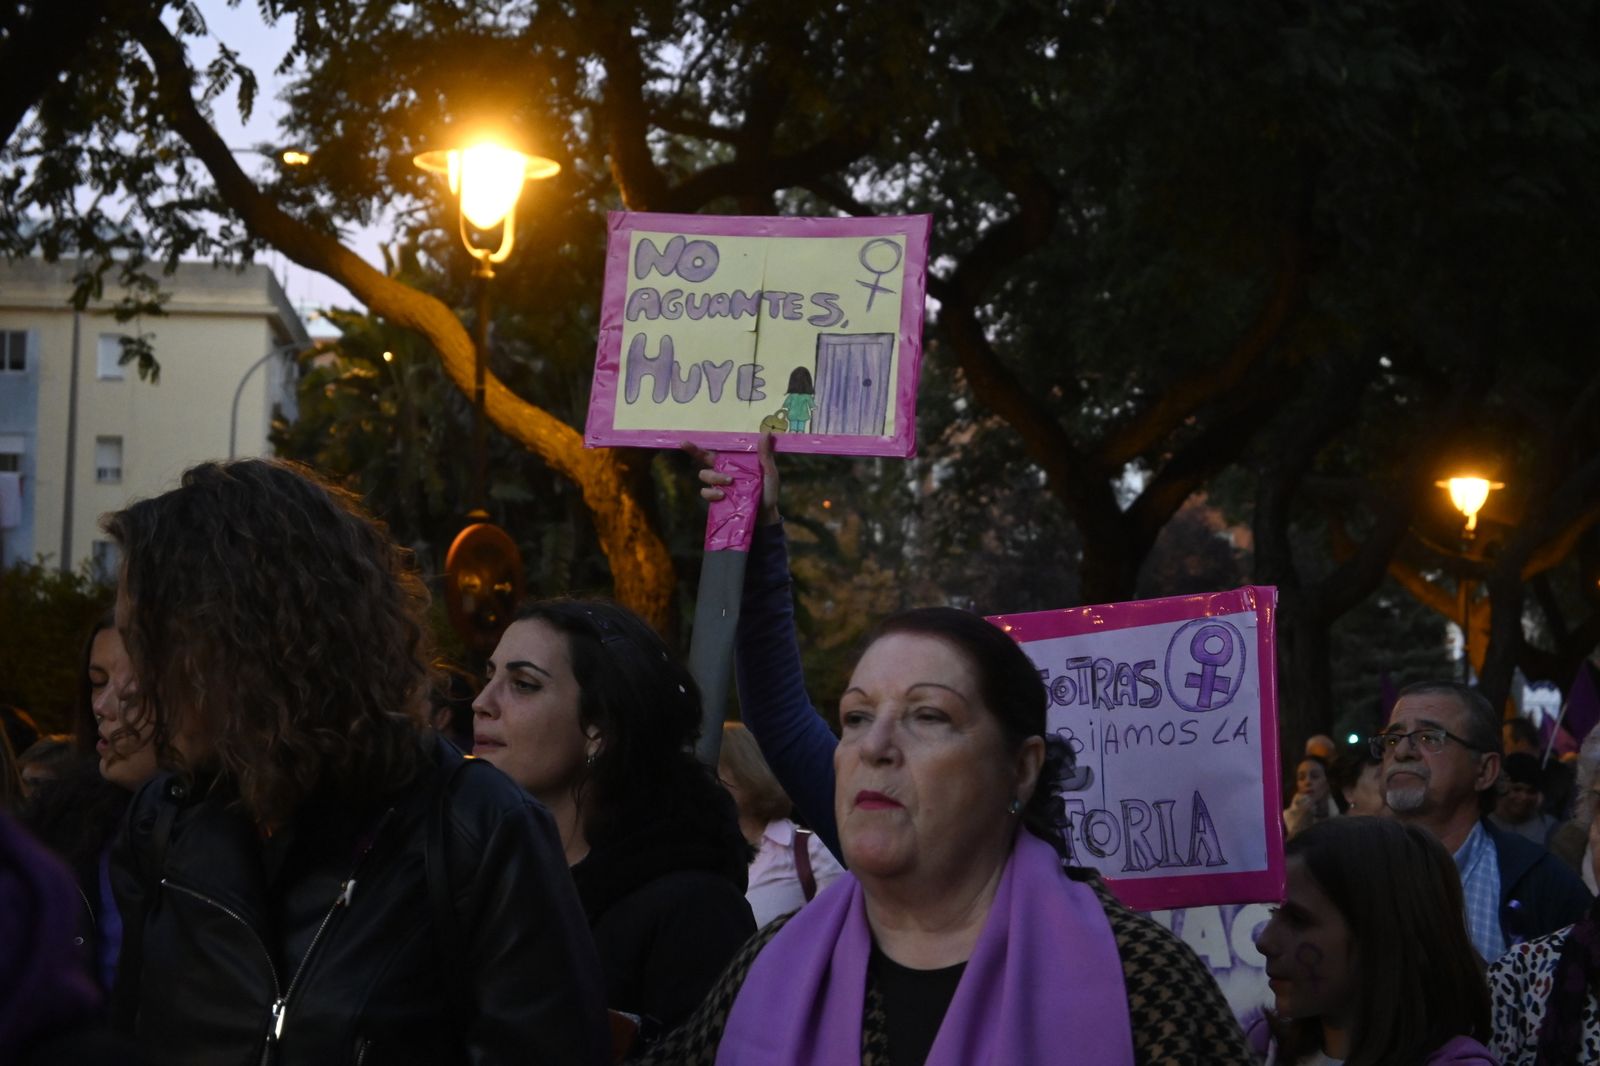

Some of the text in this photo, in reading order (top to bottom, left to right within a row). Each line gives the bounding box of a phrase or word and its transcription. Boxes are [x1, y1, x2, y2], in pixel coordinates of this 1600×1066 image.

[634, 235, 720, 283] NO
[626, 287, 850, 329] AGUANTES,
[624, 332, 767, 405] HUYE
[1212, 716, 1249, 745] LA
